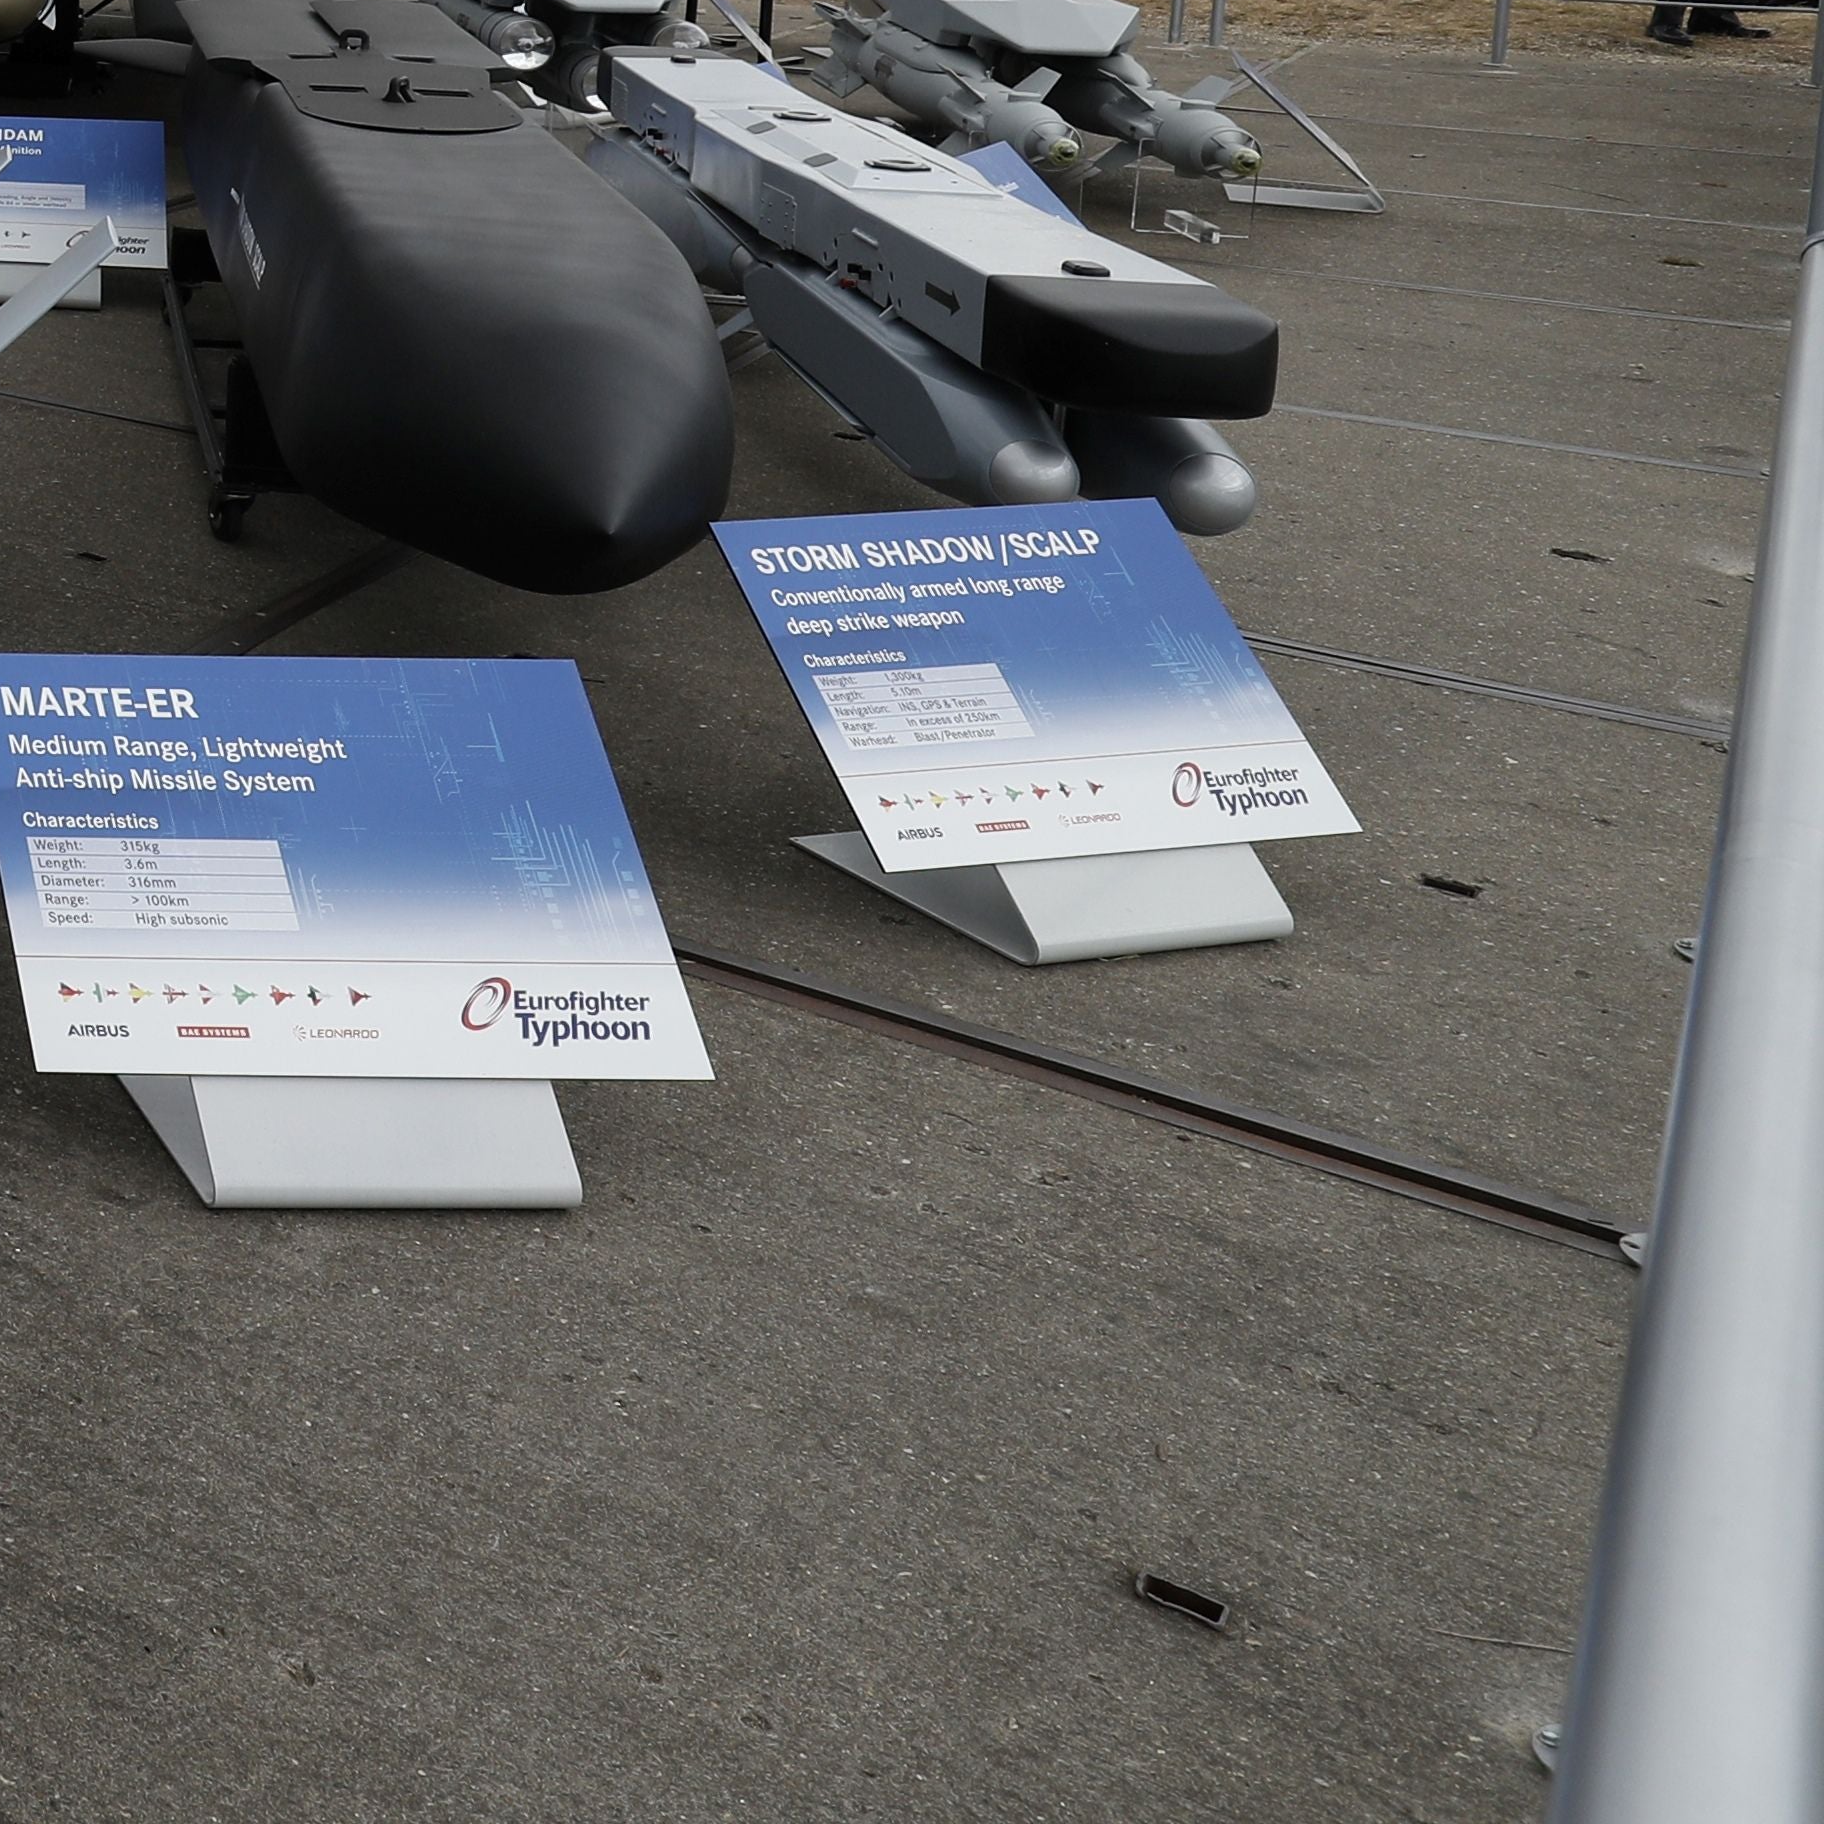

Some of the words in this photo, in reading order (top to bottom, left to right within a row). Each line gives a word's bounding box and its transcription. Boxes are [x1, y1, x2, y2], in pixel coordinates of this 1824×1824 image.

[751, 543, 860, 574] STORM
[771, 582, 906, 607] Conventionally
[909, 577, 969, 598] armed
[967, 577, 1014, 597] long
[1012, 575, 1065, 594] range
[786, 616, 834, 638] deep
[836, 611, 890, 632] strike
[890, 610, 965, 630] weapon
[803, 648, 907, 668] Characteristics
[0, 686, 199, 719] MARTE-ER
[8, 734, 107, 756] Medium
[113, 735, 197, 762] Range,
[202, 736, 348, 764] Lightweight
[16, 767, 124, 794] Anti-ship
[129, 768, 217, 791] Missile
[223, 770, 315, 796] System
[1197, 767, 1298, 788] Eurofighter
[1209, 785, 1309, 817] Typhoon
[22, 811, 159, 829] Characteristics
[33, 839, 83, 853] Weight:
[120, 840, 160, 855] 315kg
[37, 856, 86, 872] Length:
[124, 858, 158, 870] 3.6m
[40, 874, 105, 888] Diameter:
[128, 876, 177, 888] 316mm
[44, 893, 89, 908] Range:
[131, 896, 139, 904] >
[145, 894, 189, 906] 100km
[48, 911, 93, 926] Speed:
[135, 912, 167, 928] High
[169, 913, 228, 926] subsonic
[513, 990, 650, 1014] Eurofighter
[514, 1012, 651, 1047] Typhoon
